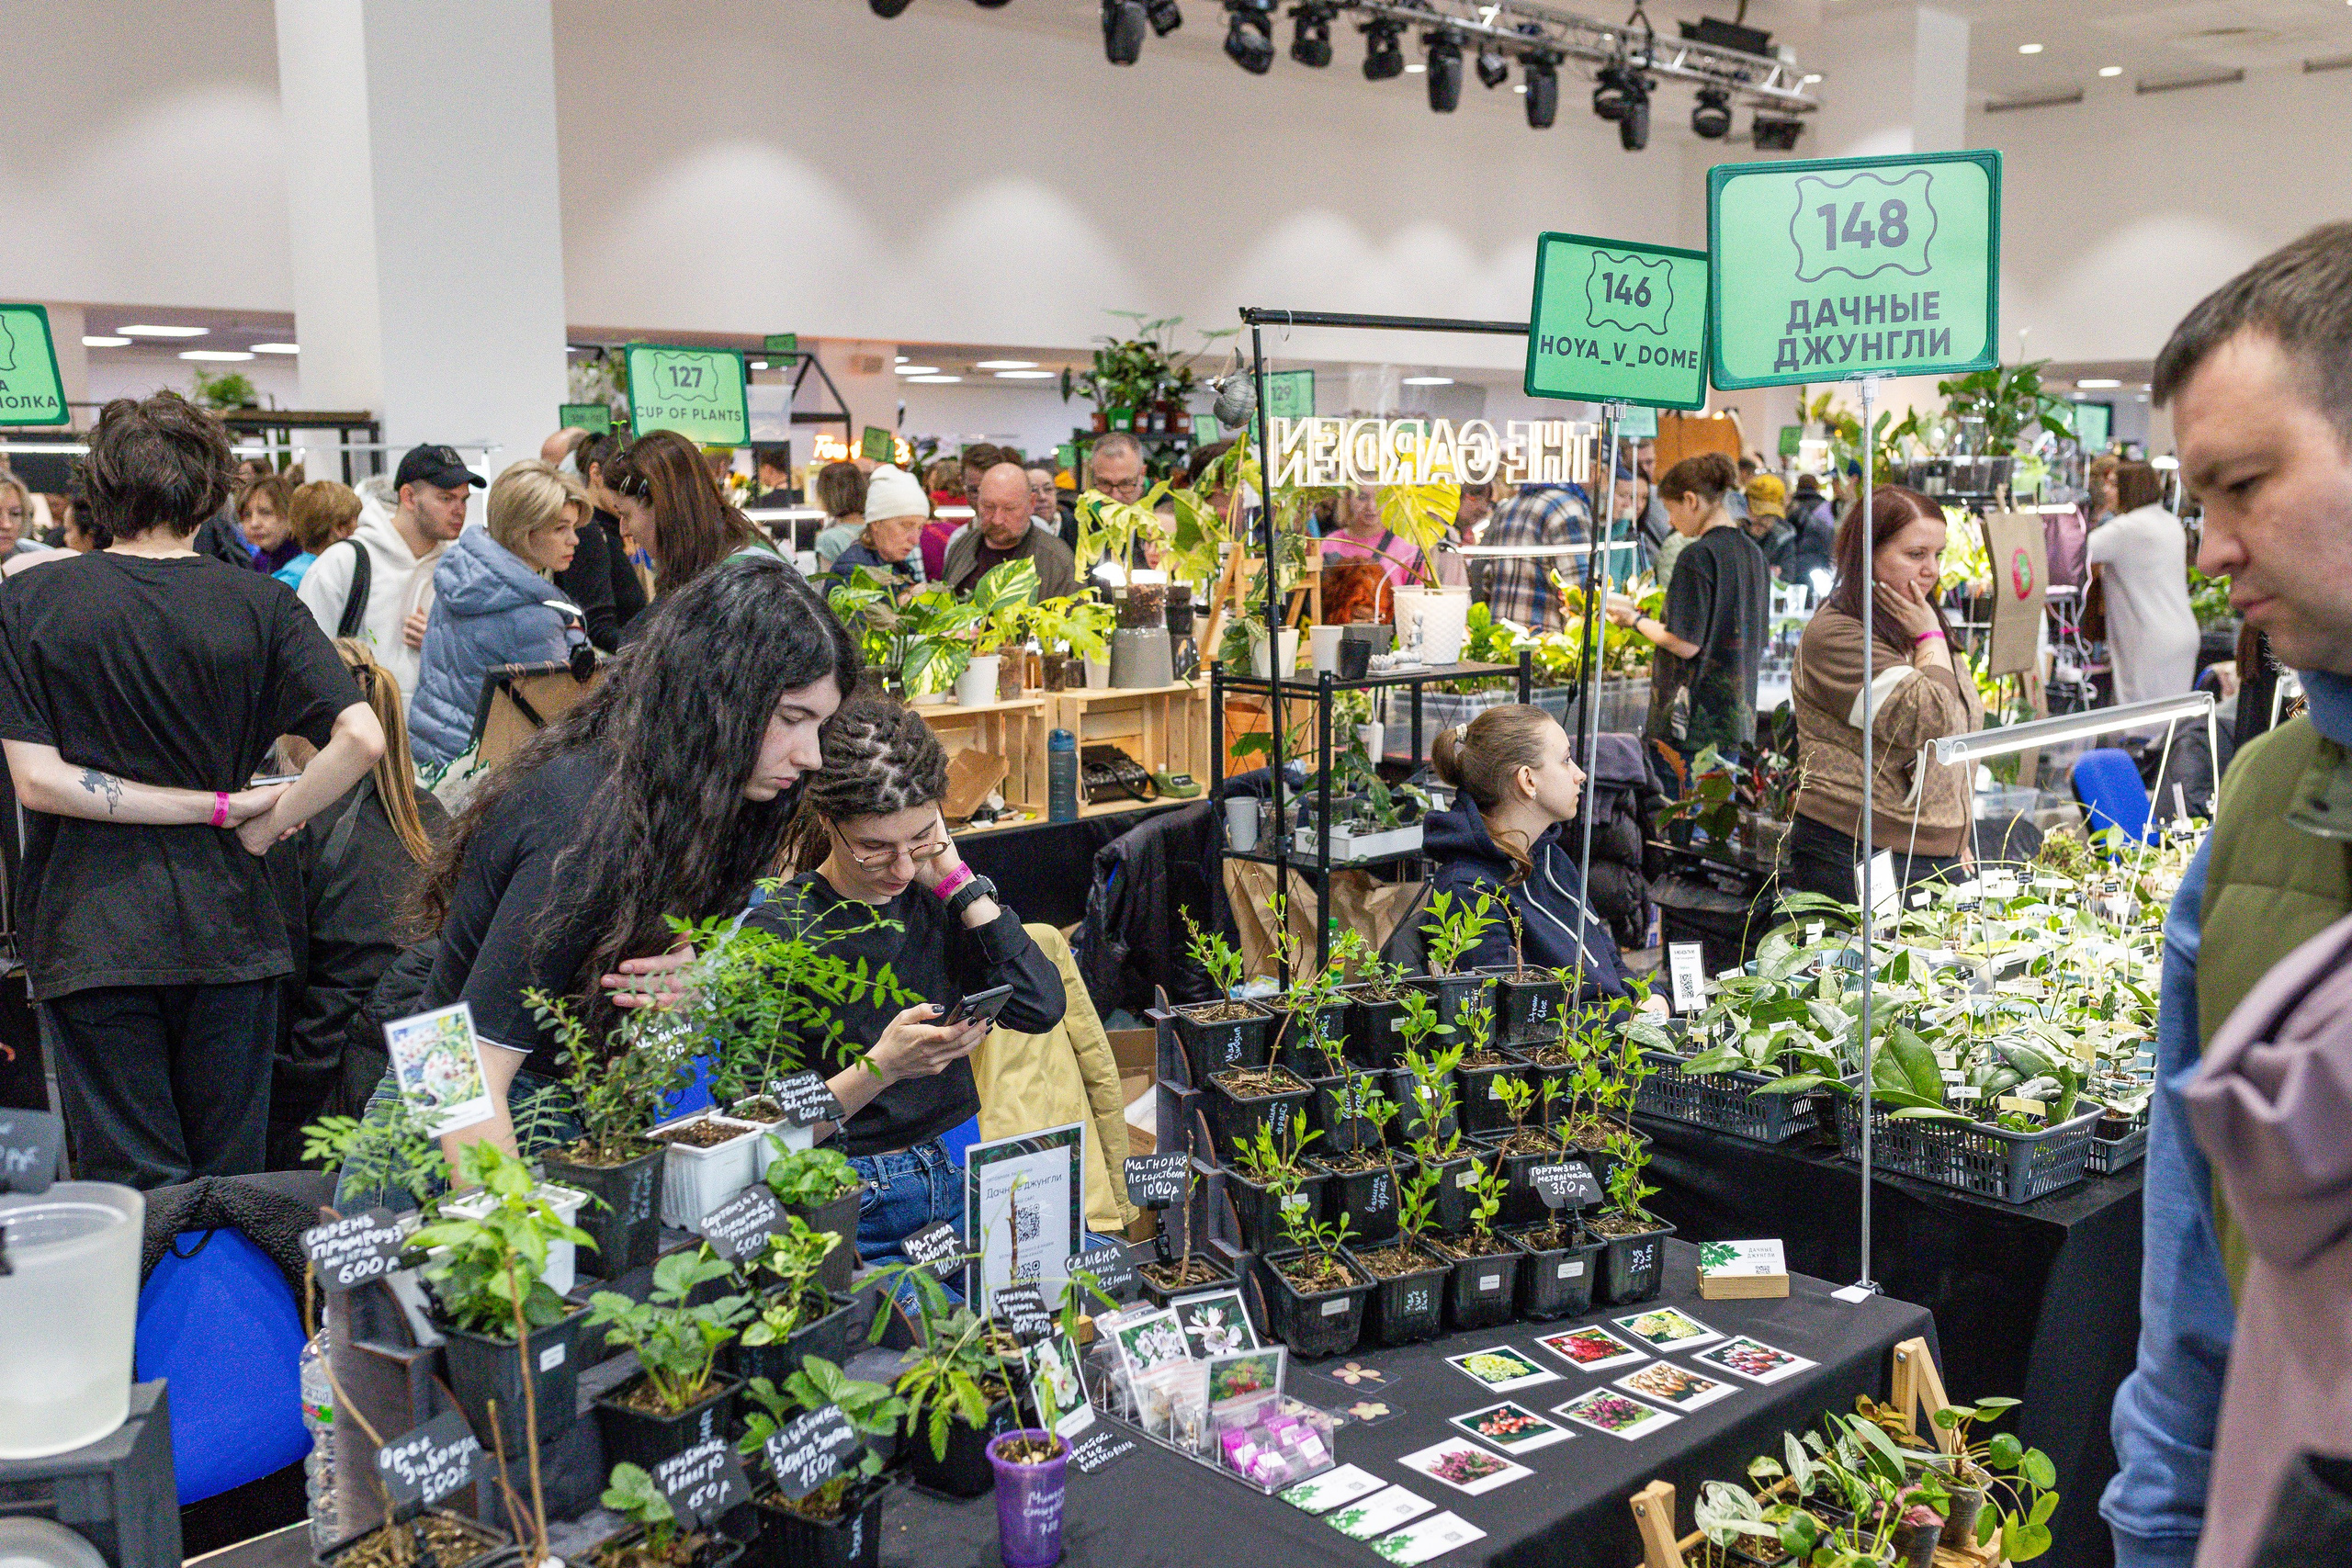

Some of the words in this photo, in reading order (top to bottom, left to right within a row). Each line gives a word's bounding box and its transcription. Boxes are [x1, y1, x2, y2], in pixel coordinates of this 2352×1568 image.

[1816, 198, 1909, 251] 148
[1602, 272, 1652, 308] 146
[1786, 290, 1940, 335] ДАЧНЫЕ
[1540, 334, 1698, 369] HOYA_V_DOME
[1773, 327, 1951, 373] ДЖУНГЛИ
[669, 366, 703, 388] 127
[0, 395, 59, 409] ОЛКА
[636, 405, 663, 418] CUP
[670, 407, 687, 419] OF
[693, 409, 742, 423] PLANTS
[1125, 1156, 1188, 1172] Магнолия
[1531, 1163, 1582, 1177] Гортензия
[1128, 1167, 1192, 1185] Лекарственн
[986, 1185, 1023, 1200] Дачне
[1551, 1180, 1576, 1195] 350
[338, 1256, 375, 1283] 600
[1067, 1247, 1121, 1271] Семена
